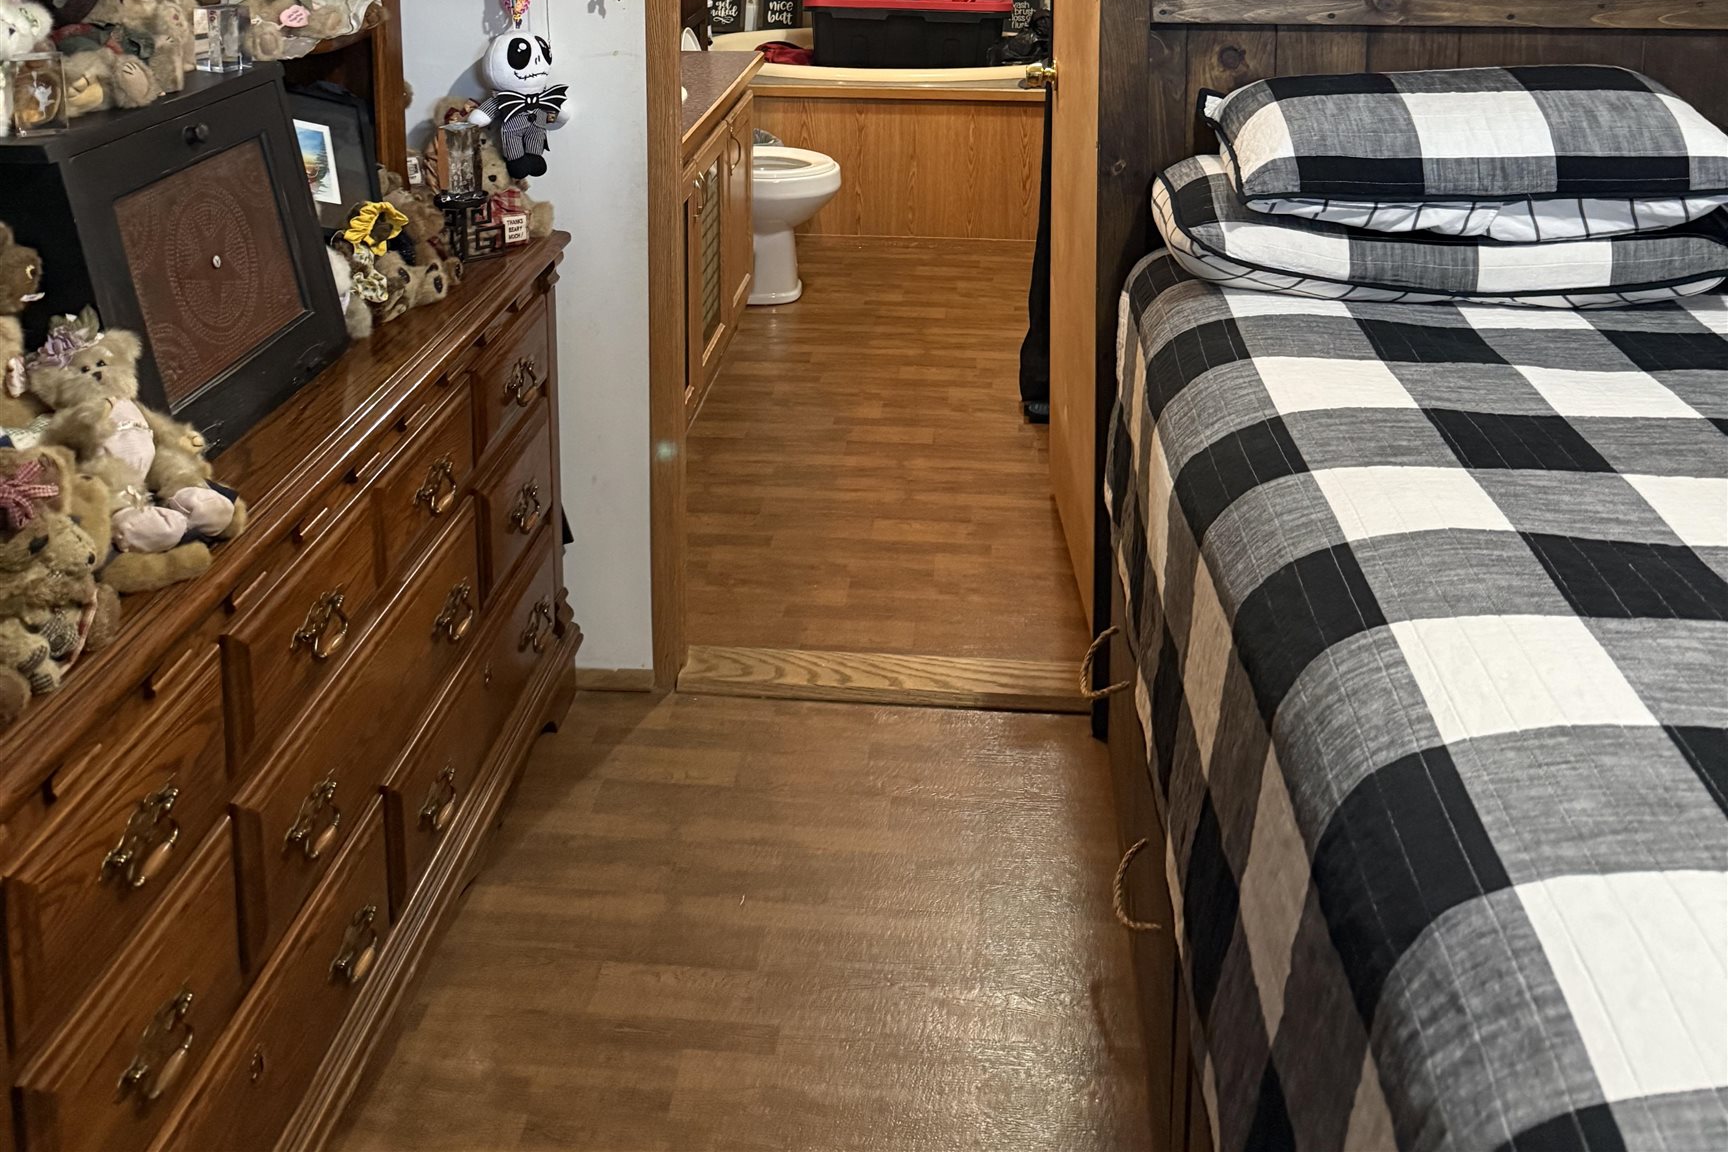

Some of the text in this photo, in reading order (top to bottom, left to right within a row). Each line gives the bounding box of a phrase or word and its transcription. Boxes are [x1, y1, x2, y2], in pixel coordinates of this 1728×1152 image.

[769, 1, 794, 12] nice
[1013, 1, 1030, 9] ash
[767, 10, 793, 25] butt
